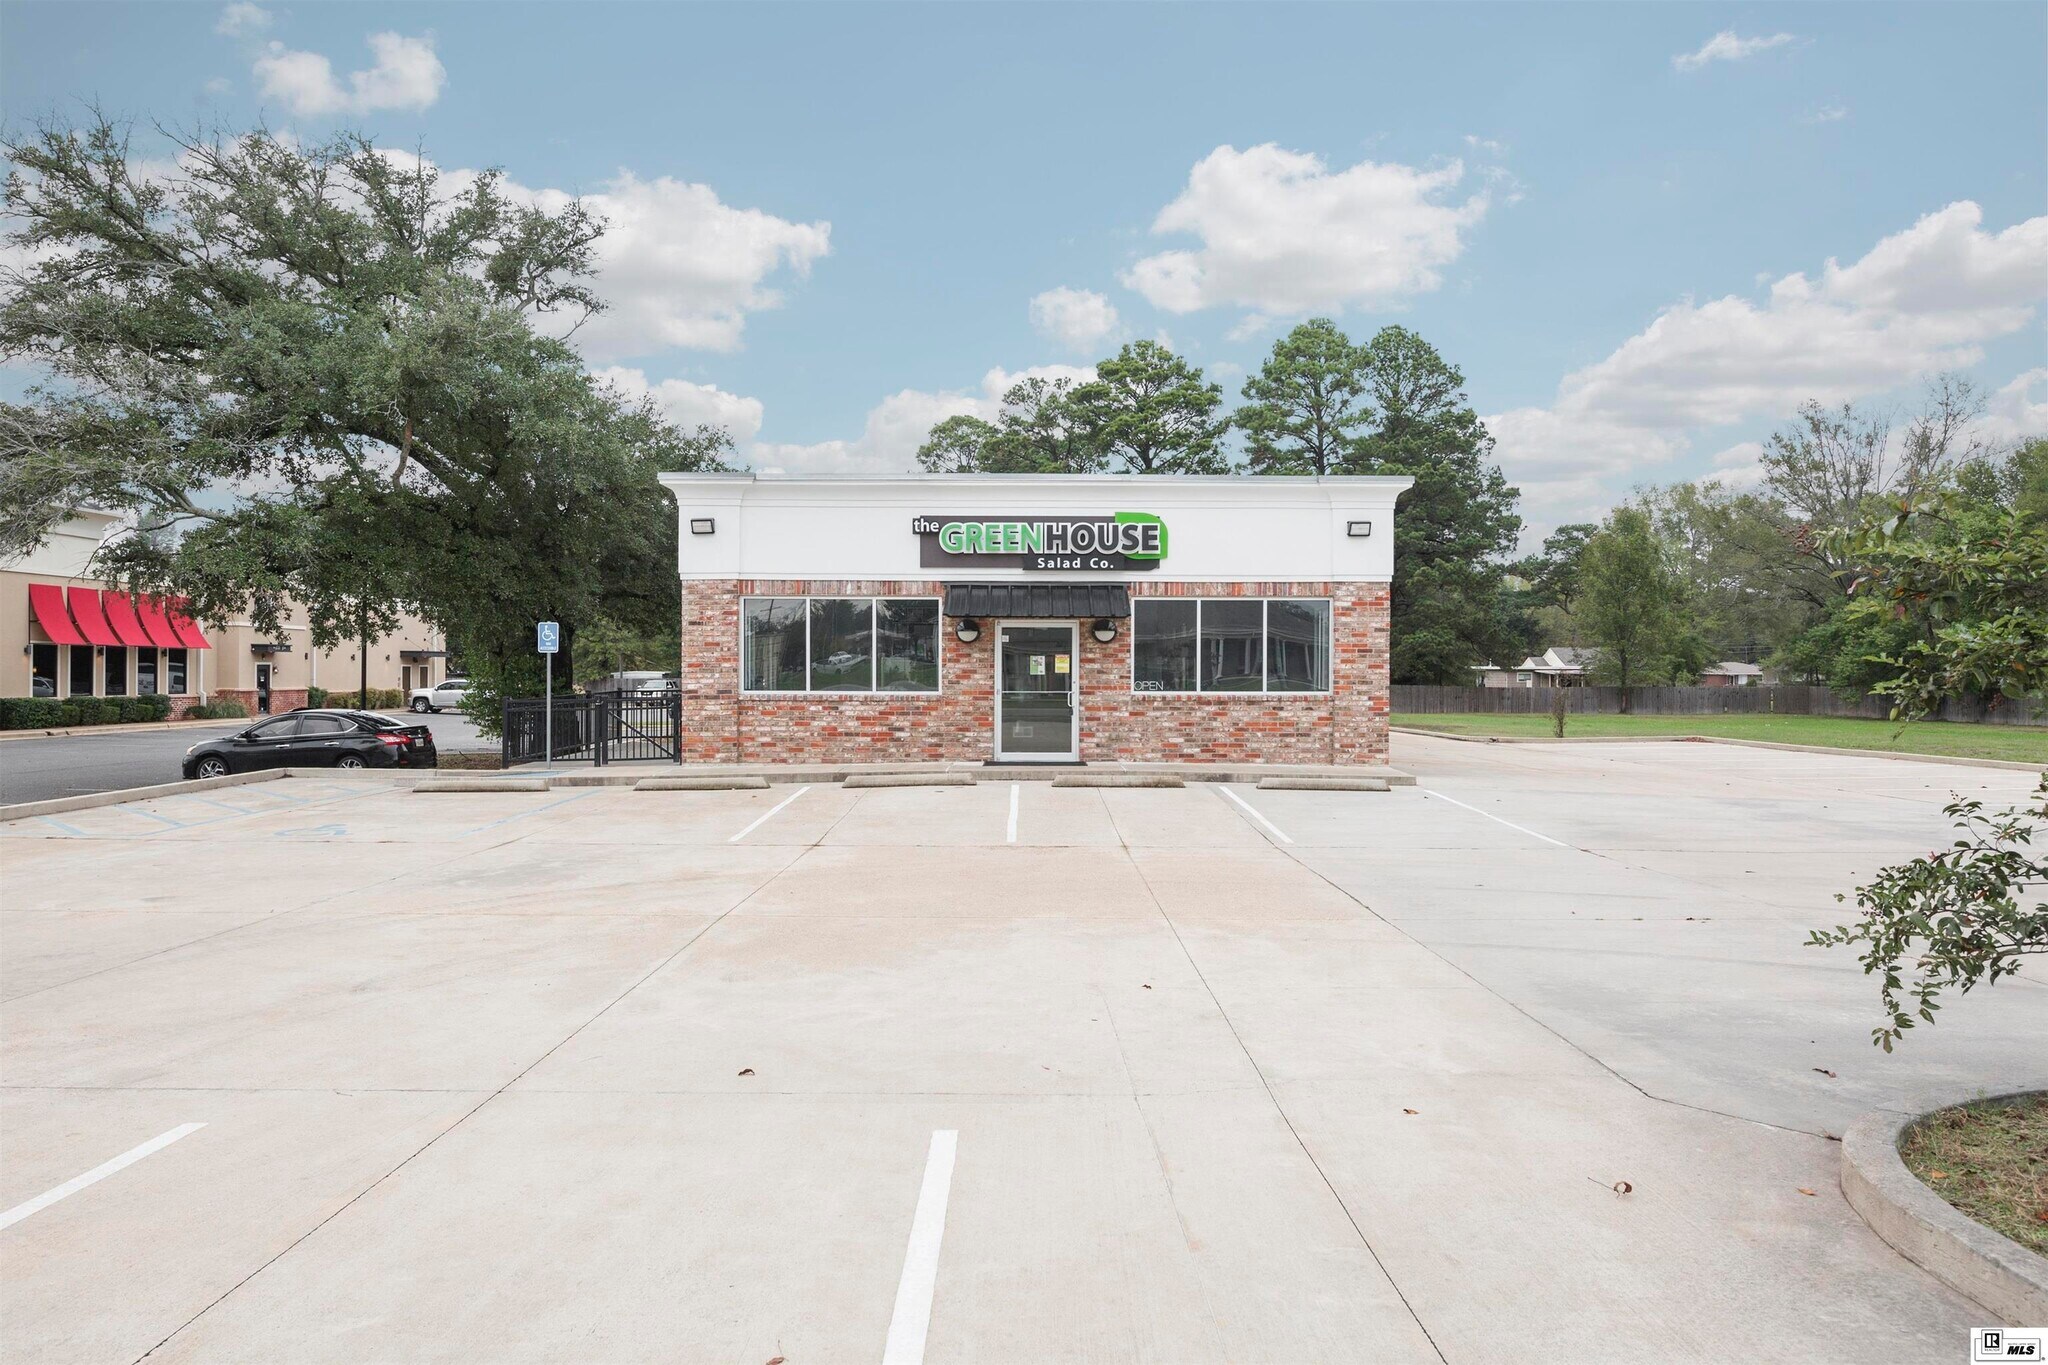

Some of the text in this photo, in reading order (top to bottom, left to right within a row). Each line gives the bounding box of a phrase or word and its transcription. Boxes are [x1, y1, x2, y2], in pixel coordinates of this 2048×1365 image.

[913, 519, 939, 532] the
[939, 522, 1161, 554] GREENHOUSE
[1037, 557, 1115, 569] Salad Co.
[1134, 681, 1164, 690] OPEN
